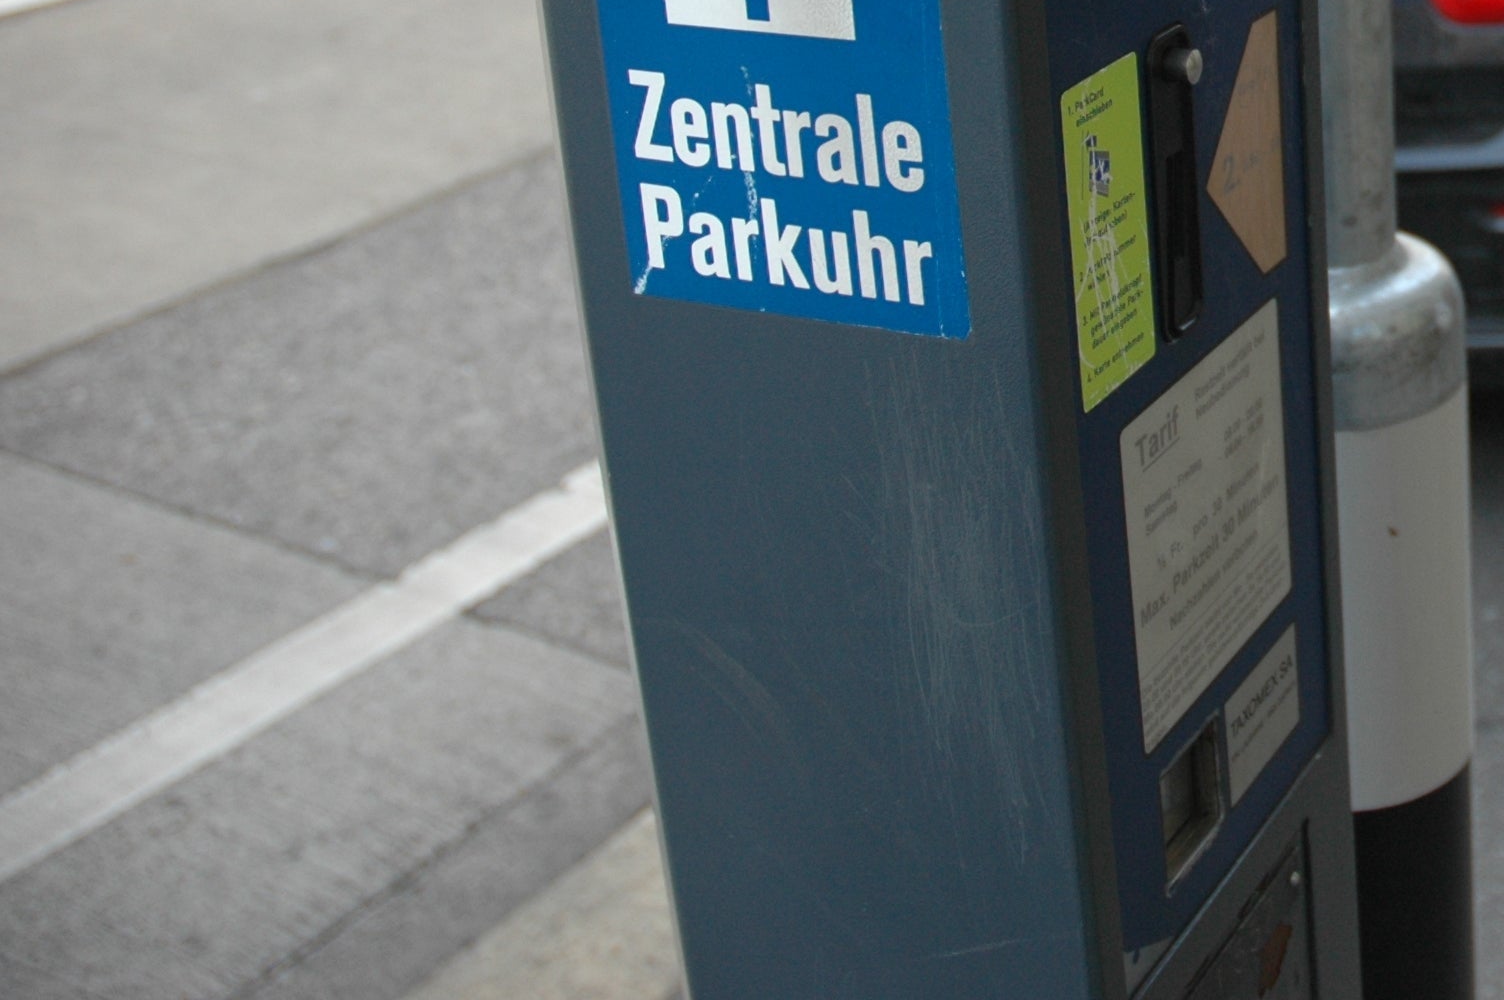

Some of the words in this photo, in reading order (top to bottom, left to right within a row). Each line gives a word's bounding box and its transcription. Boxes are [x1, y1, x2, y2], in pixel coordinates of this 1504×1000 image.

[628, 68, 926, 193] Zentrale
[639, 182, 932, 306] Parkuhr
[1135, 406, 1178, 466] Tarif
[1140, 592, 1170, 627] Max.
[1172, 533, 1219, 593] Parkzeit
[1221, 516, 1235, 542] 30
[1237, 474, 1279, 525] Minuten
